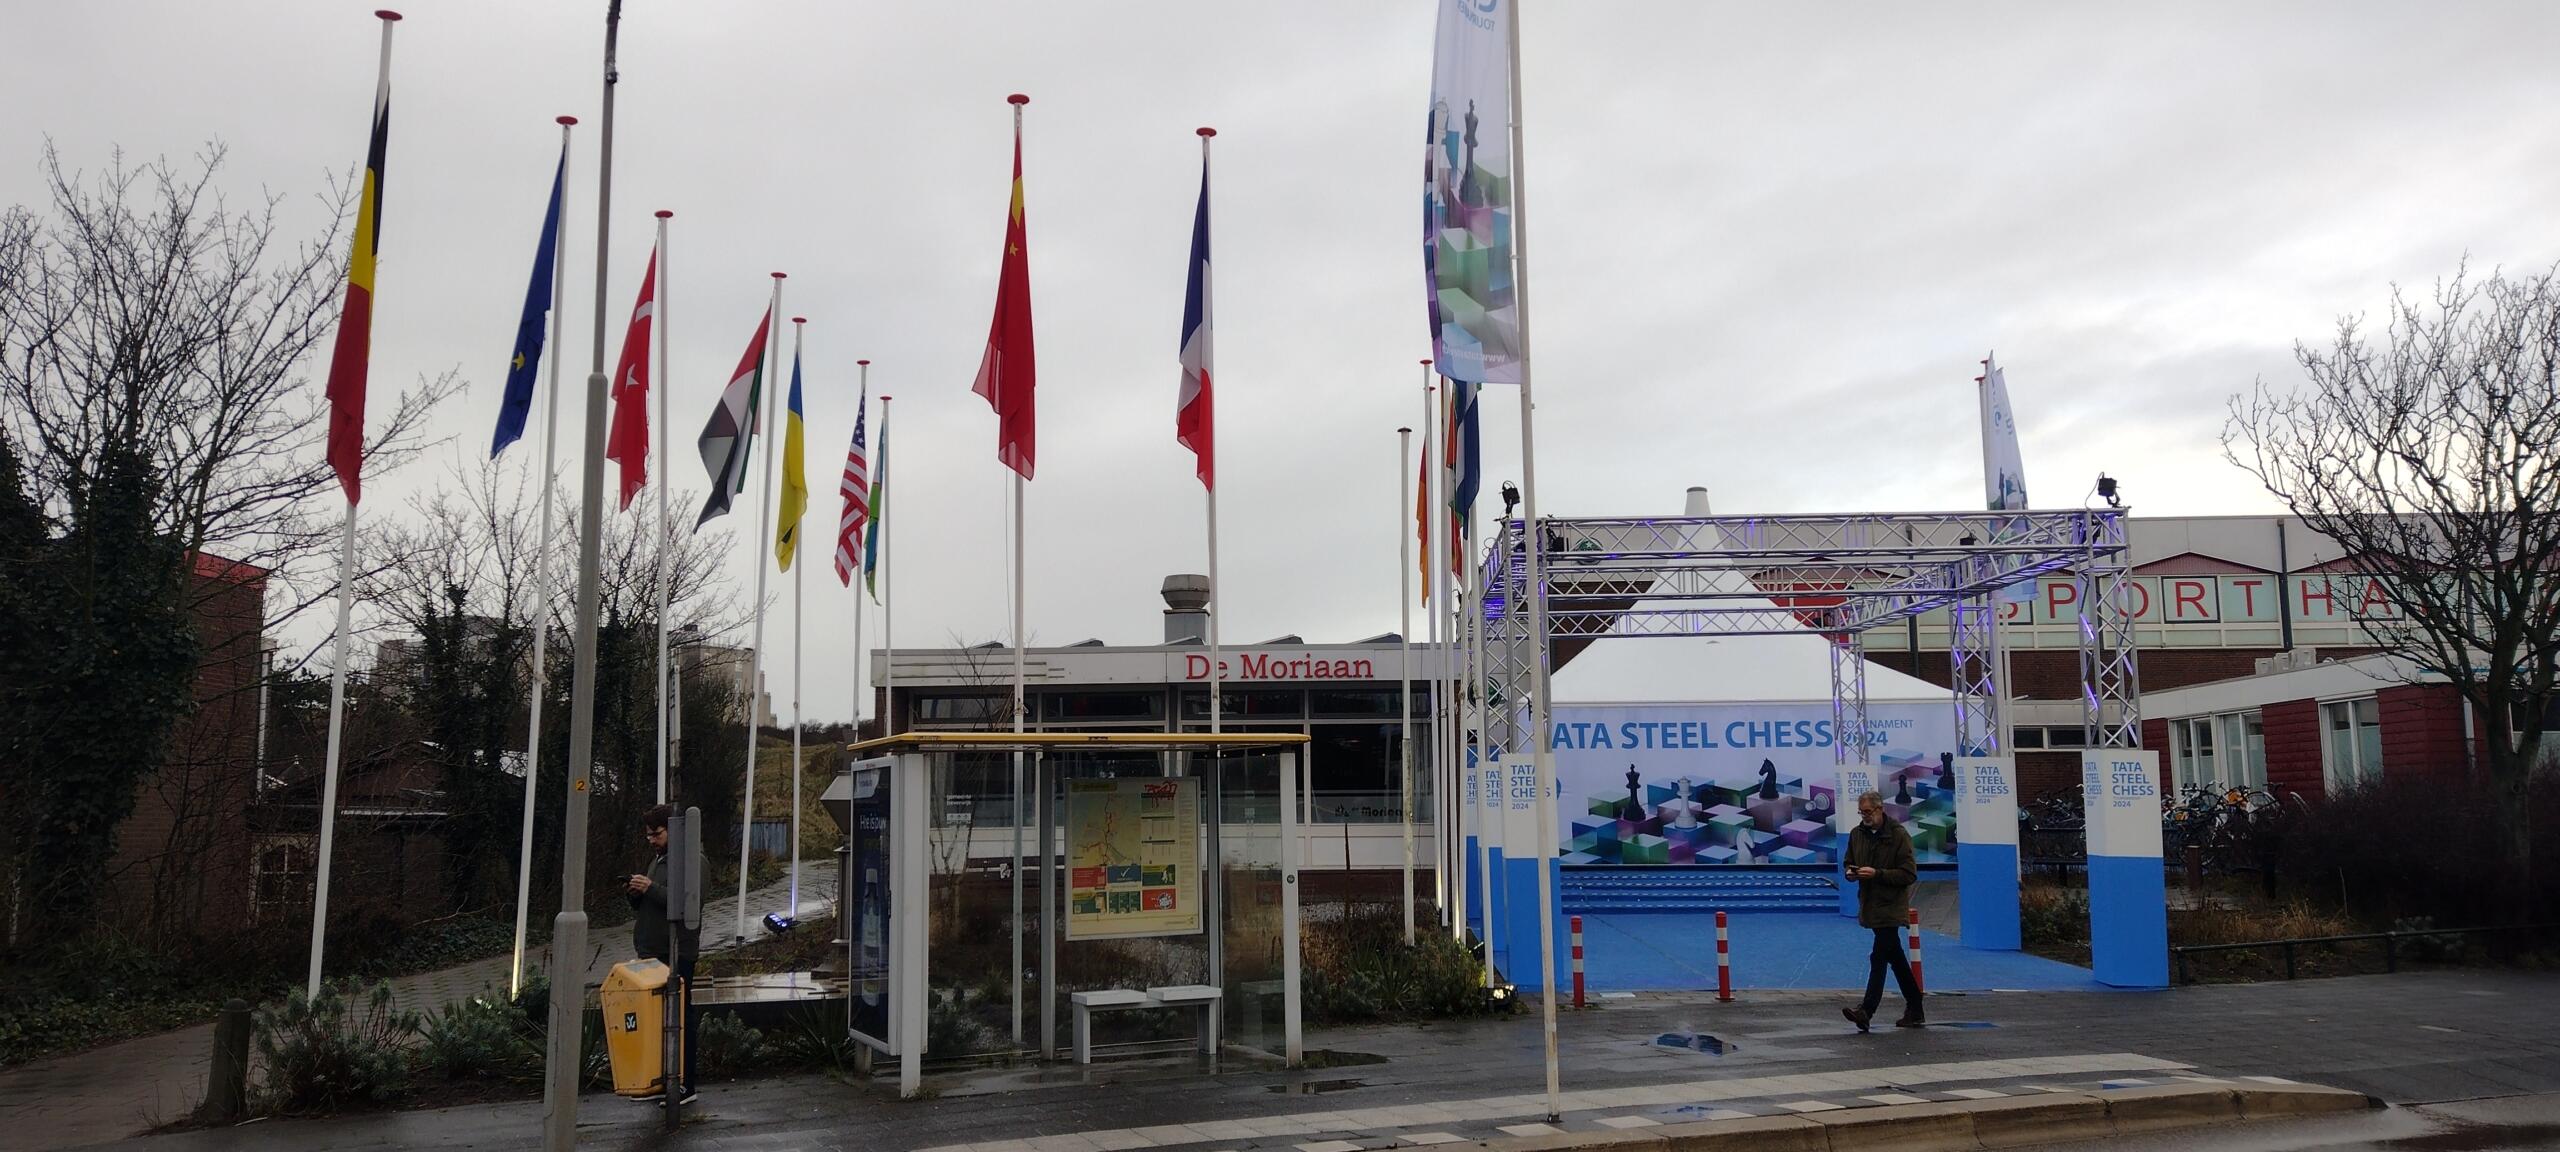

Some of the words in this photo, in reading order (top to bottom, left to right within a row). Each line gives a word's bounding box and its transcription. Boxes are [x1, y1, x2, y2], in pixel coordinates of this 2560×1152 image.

[1240, 653, 1374, 679] Moriaan
[1551, 722, 1613, 749] ATA
[1621, 721, 1718, 749] STEEL
[1725, 719, 1834, 748] CHESS
[1974, 766, 2000, 775] TATA
[2111, 761, 2143, 772] TATA
[1847, 771, 1868, 780] TATA
[1974, 775, 2006, 785] STEEL
[2112, 773, 2150, 784] STEEL
[577, 780, 585, 791] 2
[1847, 779, 1873, 787] STEEL
[1975, 785, 2009, 795] CHESS
[2112, 785, 2154, 796] CHESS
[1511, 802, 1529, 810] 2024
